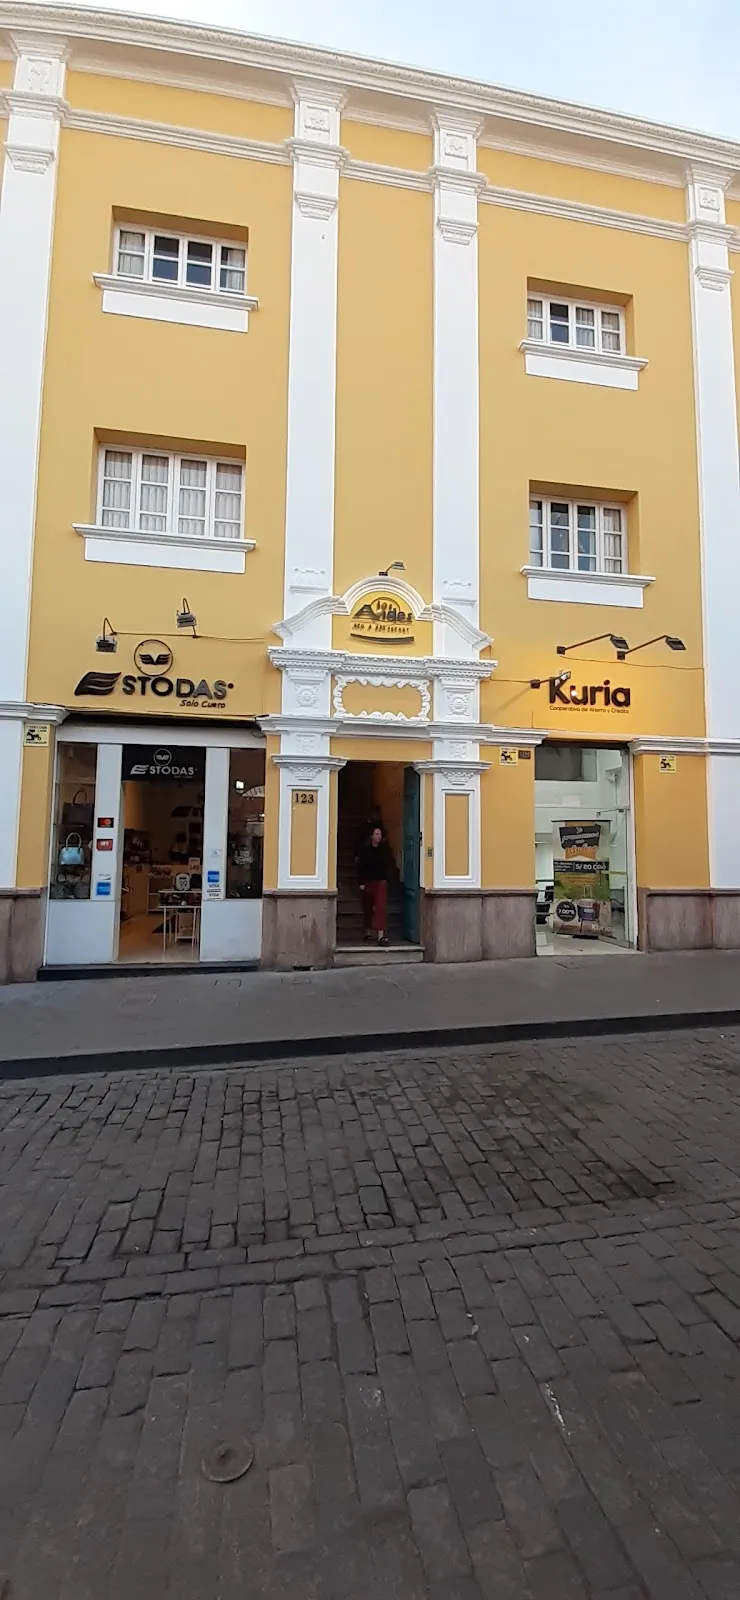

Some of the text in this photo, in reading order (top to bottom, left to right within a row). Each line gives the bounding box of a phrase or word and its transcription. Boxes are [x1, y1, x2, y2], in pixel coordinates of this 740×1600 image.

[549, 677, 631, 708] Kuria
[179, 699, 226, 709] Solo Cuero
[295, 792, 314, 804] 123
